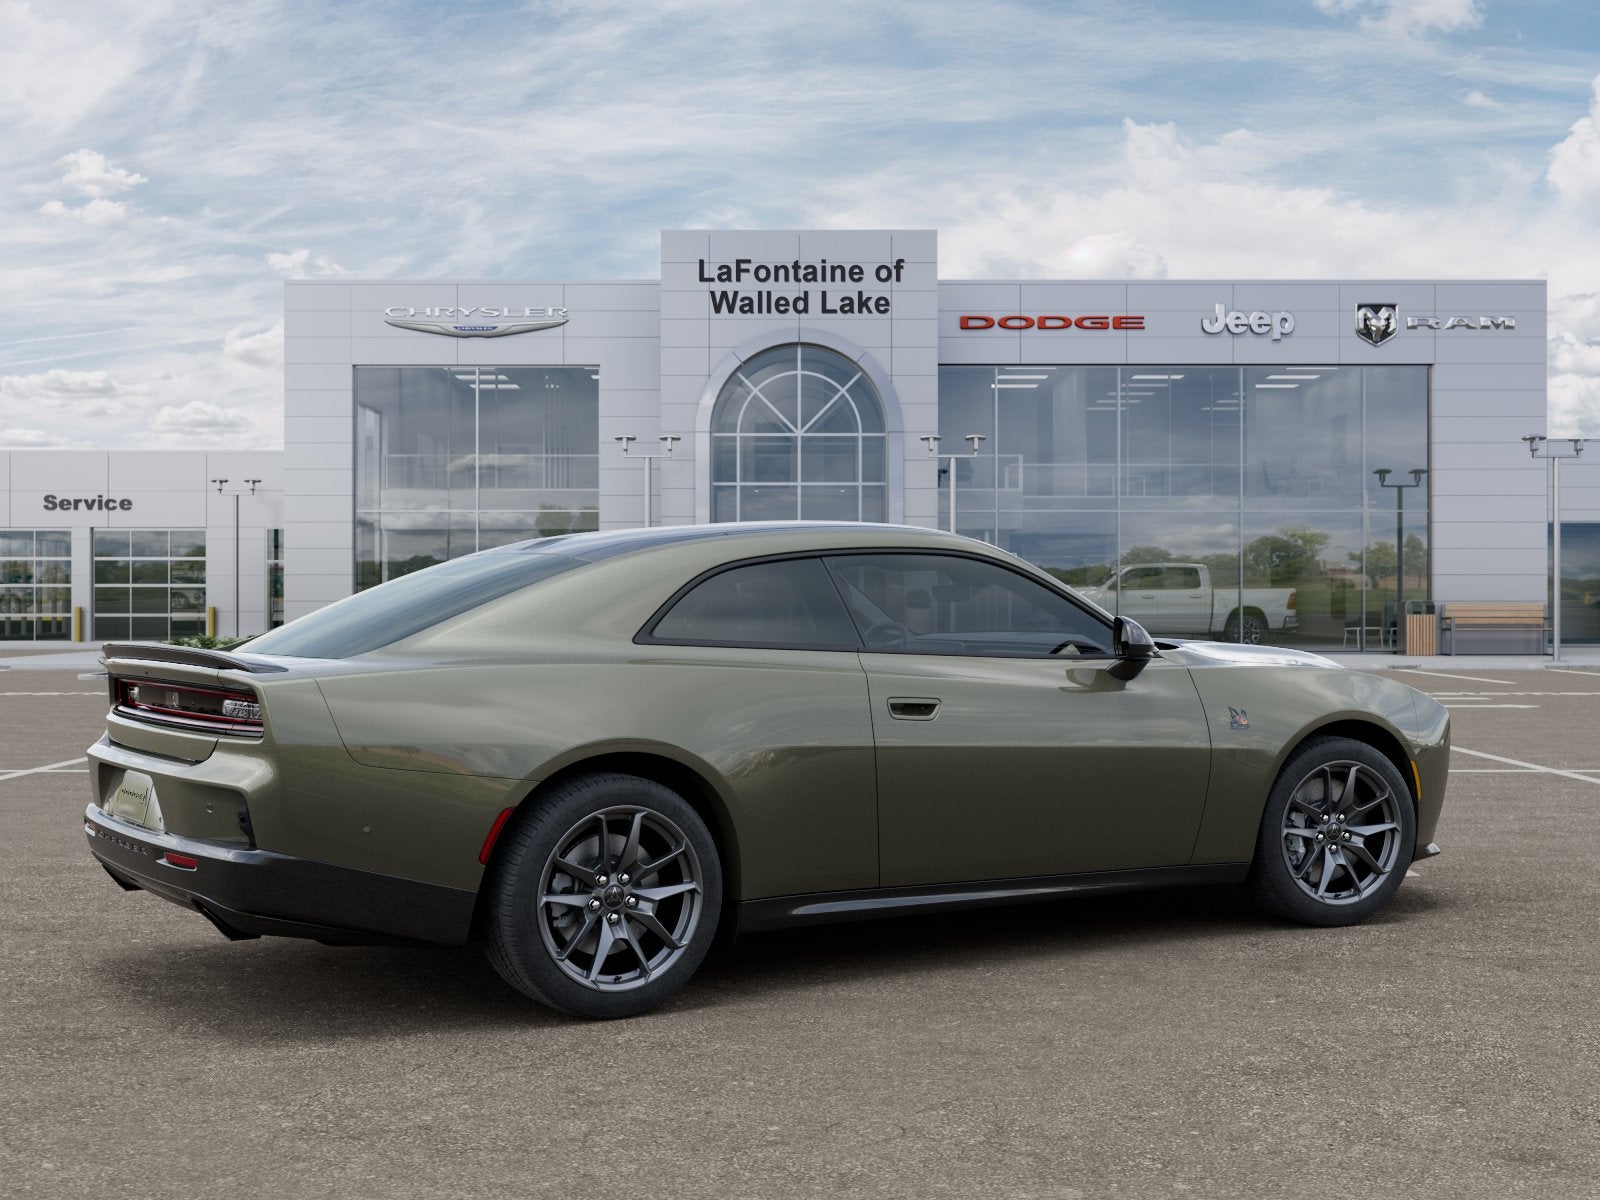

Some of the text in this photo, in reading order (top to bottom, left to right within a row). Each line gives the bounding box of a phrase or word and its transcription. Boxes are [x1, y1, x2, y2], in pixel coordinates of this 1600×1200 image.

[698, 258, 905, 283] LaFontaine of
[710, 290, 891, 315] Walled Lake
[384, 306, 569, 317] CHRYSLER
[959, 315, 1146, 330] DODGE
[1201, 302, 1296, 342] Jeep
[1406, 315, 1516, 330] RAM
[43, 494, 133, 511] Service
